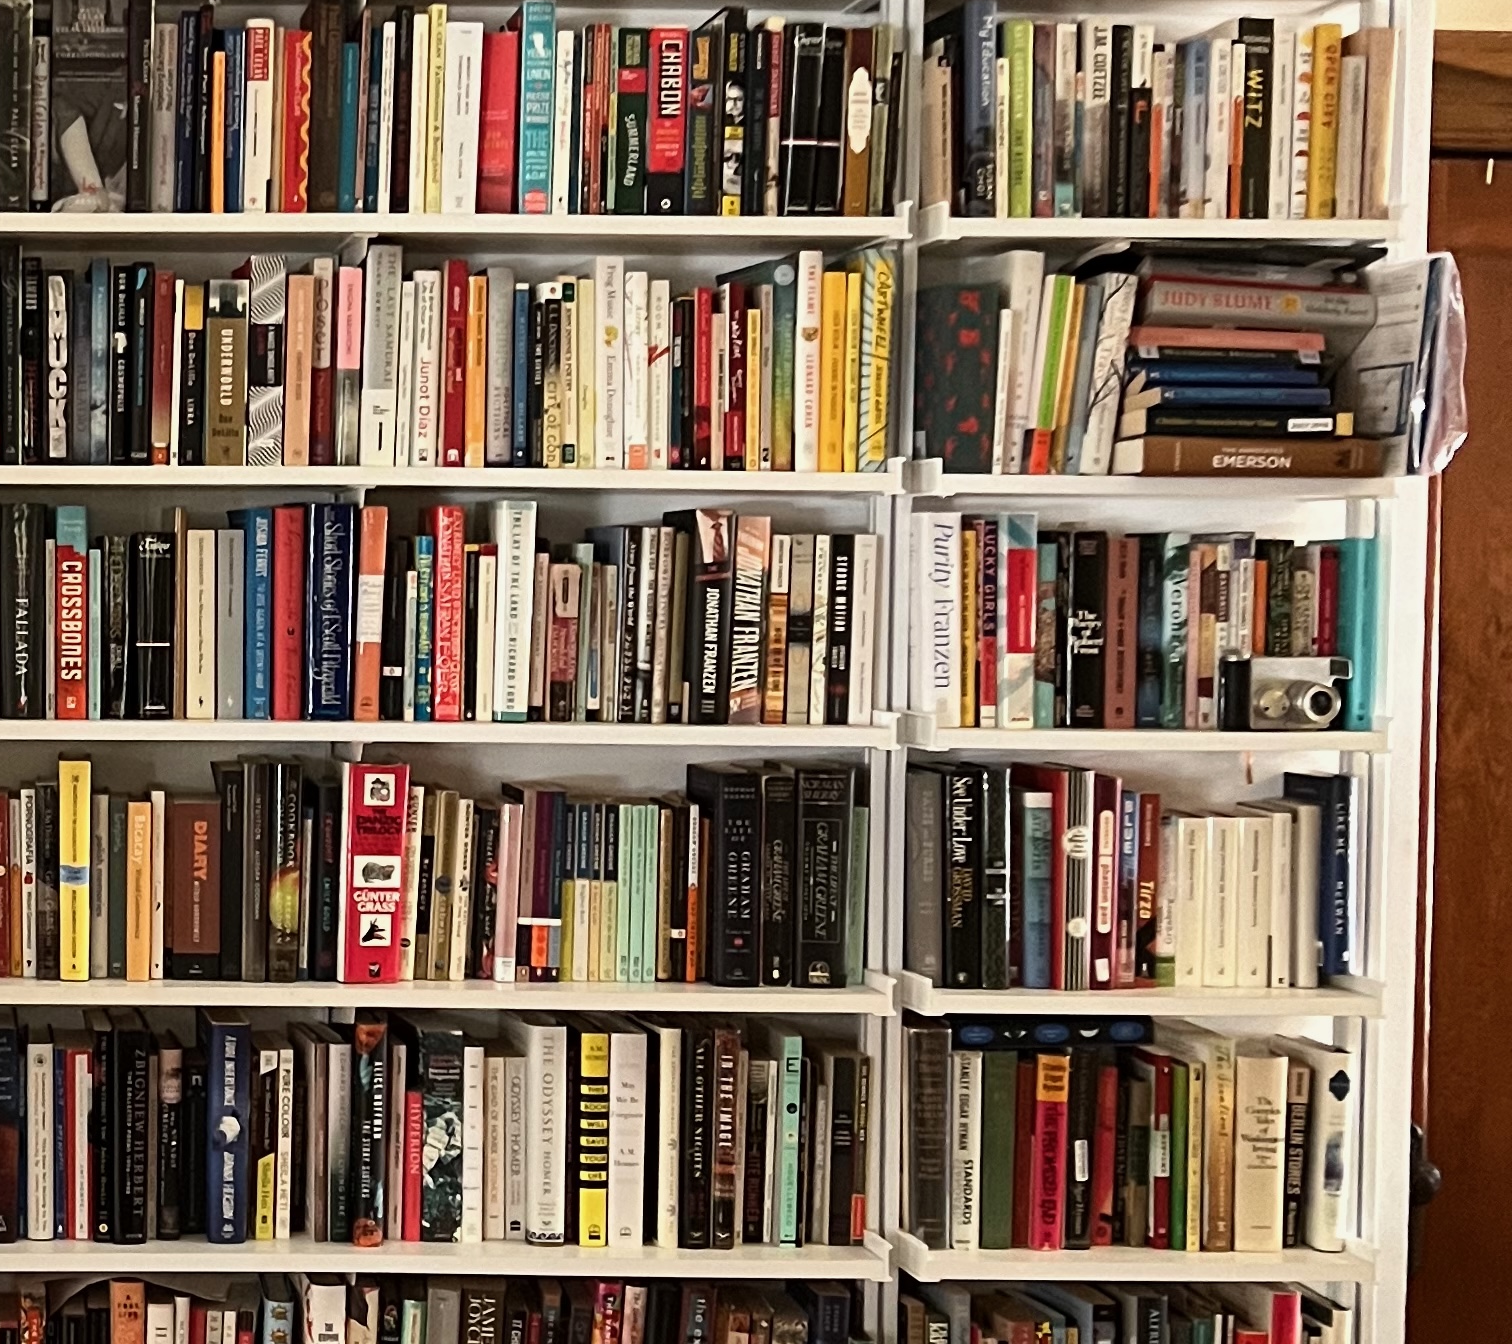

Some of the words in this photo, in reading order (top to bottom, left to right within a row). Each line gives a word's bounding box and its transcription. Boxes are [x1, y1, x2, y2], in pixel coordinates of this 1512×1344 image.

[983, 15, 994, 35] My
[662, 41, 681, 117] CHABON
[981, 37, 993, 107] Education
[1092, 52, 1107, 100] COETZEE
[1245, 68, 1264, 129] WITZ
[624, 113, 639, 187] SUMMERLAND
[386, 250, 398, 278] THE
[607, 265, 615, 288] Frog
[386, 282, 398, 313] LAST
[607, 290, 615, 320] Music
[875, 269, 891, 361] CARTWHEEL
[1160, 291, 1208, 308] JUDY
[1215, 293, 1273, 311] BLUME
[220, 328, 234, 406] UNDERWORLD
[383, 317, 396, 385] SAMURAI
[420, 356, 432, 395] Junot
[606, 356, 615, 385] Emma
[187, 398, 195, 426] LIBRA
[418, 398, 431, 439] Díaz
[606, 388, 615, 437] Donoghue
[1212, 453, 1292, 469] EMERSON
[323, 521, 344, 558] Short
[930, 523, 954, 590] Purity
[985, 524, 996, 570] LUCKY
[734, 543, 764, 629] JONATHAN
[838, 555, 849, 592] STRONG
[60, 560, 82, 682] CROSSBONES
[706, 587, 720, 637] JONATHAN
[834, 594, 846, 632] MOTION
[983, 573, 995, 631] GIRLS
[1168, 568, 1188, 663] Veronica
[14, 598, 29, 677] FALLADA
[730, 629, 759, 694] FRANZEN
[934, 595, 953, 689] Franzen
[702, 639, 718, 694] FRANZEN
[24, 794, 34, 867] PORNOGRAFIA
[133, 814, 145, 865] Bacacay
[191, 820, 208, 883] DIARY
[354, 889, 400, 904] GÜNTER
[356, 901, 397, 913] GRASS
[726, 850, 739, 918] GREENE
[739, 850, 751, 921] GRAHAM
[374, 1061, 383, 1088] ALICE
[543, 1035, 555, 1067] THE
[722, 1055, 733, 1070] IN
[134, 1049, 146, 1122] ZBIGNIEW
[282, 1068, 291, 1098] PURE
[542, 1071, 555, 1142] ODYSSEY
[721, 1073, 733, 1097] THE
[281, 1100, 291, 1140] COLOUR
[373, 1091, 382, 1141] HOFFMAN
[408, 1103, 422, 1175] HYPERION
[719, 1100, 733, 1147] IMAGE
[133, 1126, 145, 1216] HERBERT
[541, 1146, 552, 1196] HOMER
[962, 1159, 974, 1227] STANDARDS
[695, 1298, 706, 1326] the
